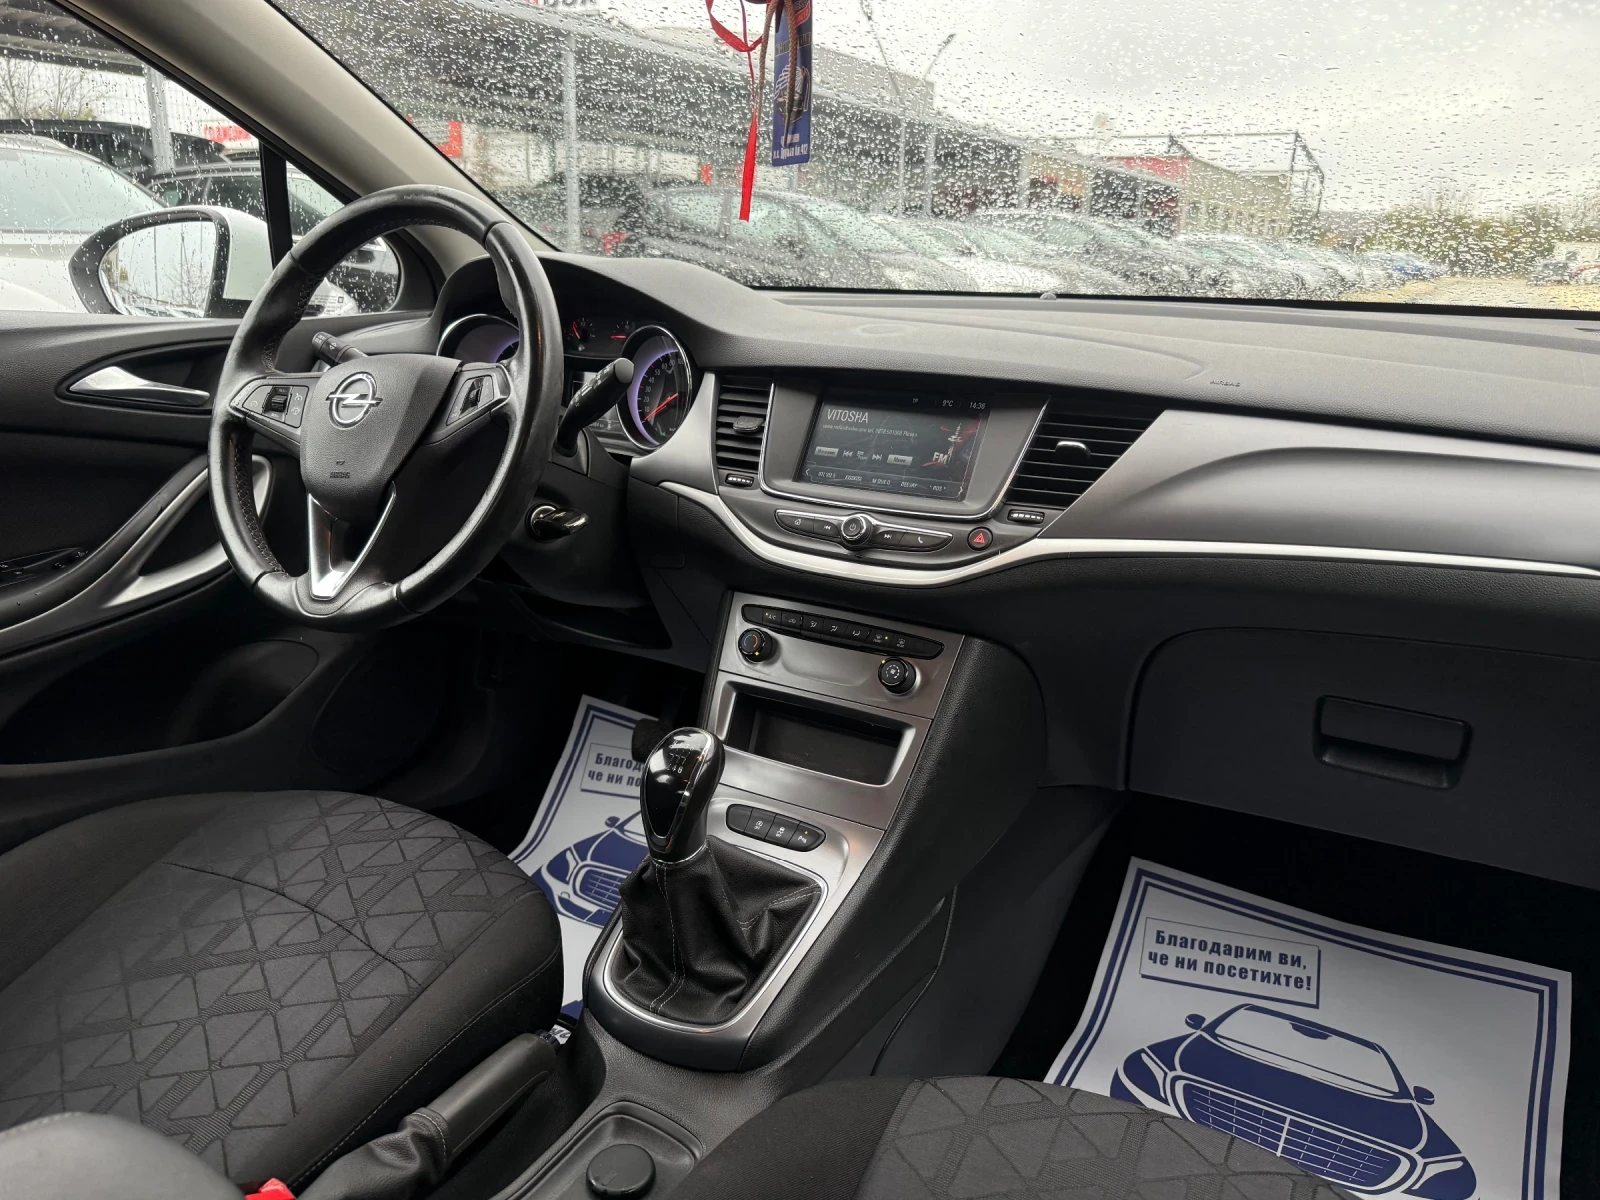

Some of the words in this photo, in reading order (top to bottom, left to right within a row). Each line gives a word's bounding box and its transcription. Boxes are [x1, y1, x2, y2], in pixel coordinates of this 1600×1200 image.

[827, 408, 869, 424] VITOSHA
[932, 452, 948, 464] FM
[595, 752, 642, 772] Благод
[588, 770, 604, 782] че
[606, 773, 623, 785] ни
[1155, 930, 1272, 963] Благодарим
[1278, 952, 1307, 970] ви,
[1148, 951, 1169, 966] че
[1175, 956, 1198, 971] ни
[1204, 962, 1312, 991] посетихте!
